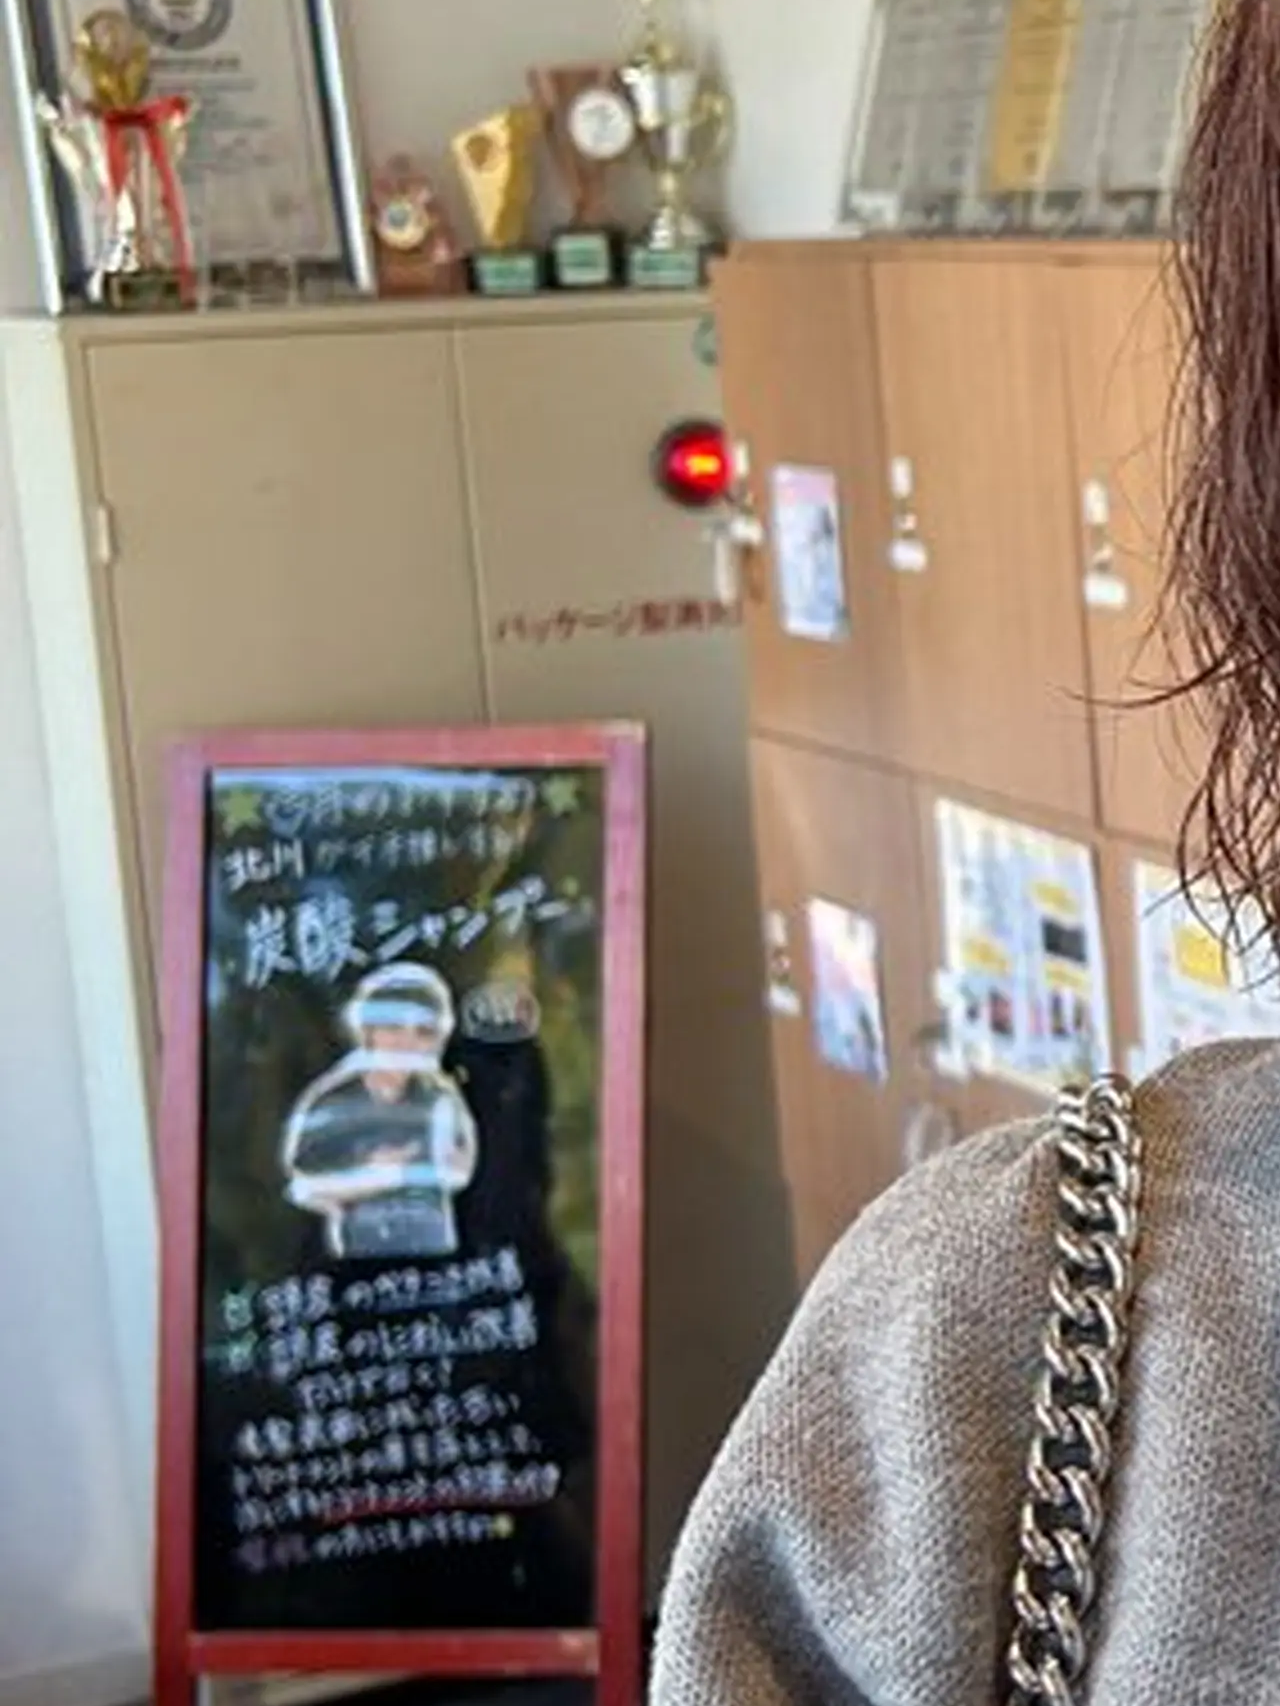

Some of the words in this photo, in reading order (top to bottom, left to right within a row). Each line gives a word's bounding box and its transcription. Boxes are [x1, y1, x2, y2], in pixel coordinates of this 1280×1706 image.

[246, 875, 573, 989] 炭酸シャンプー
